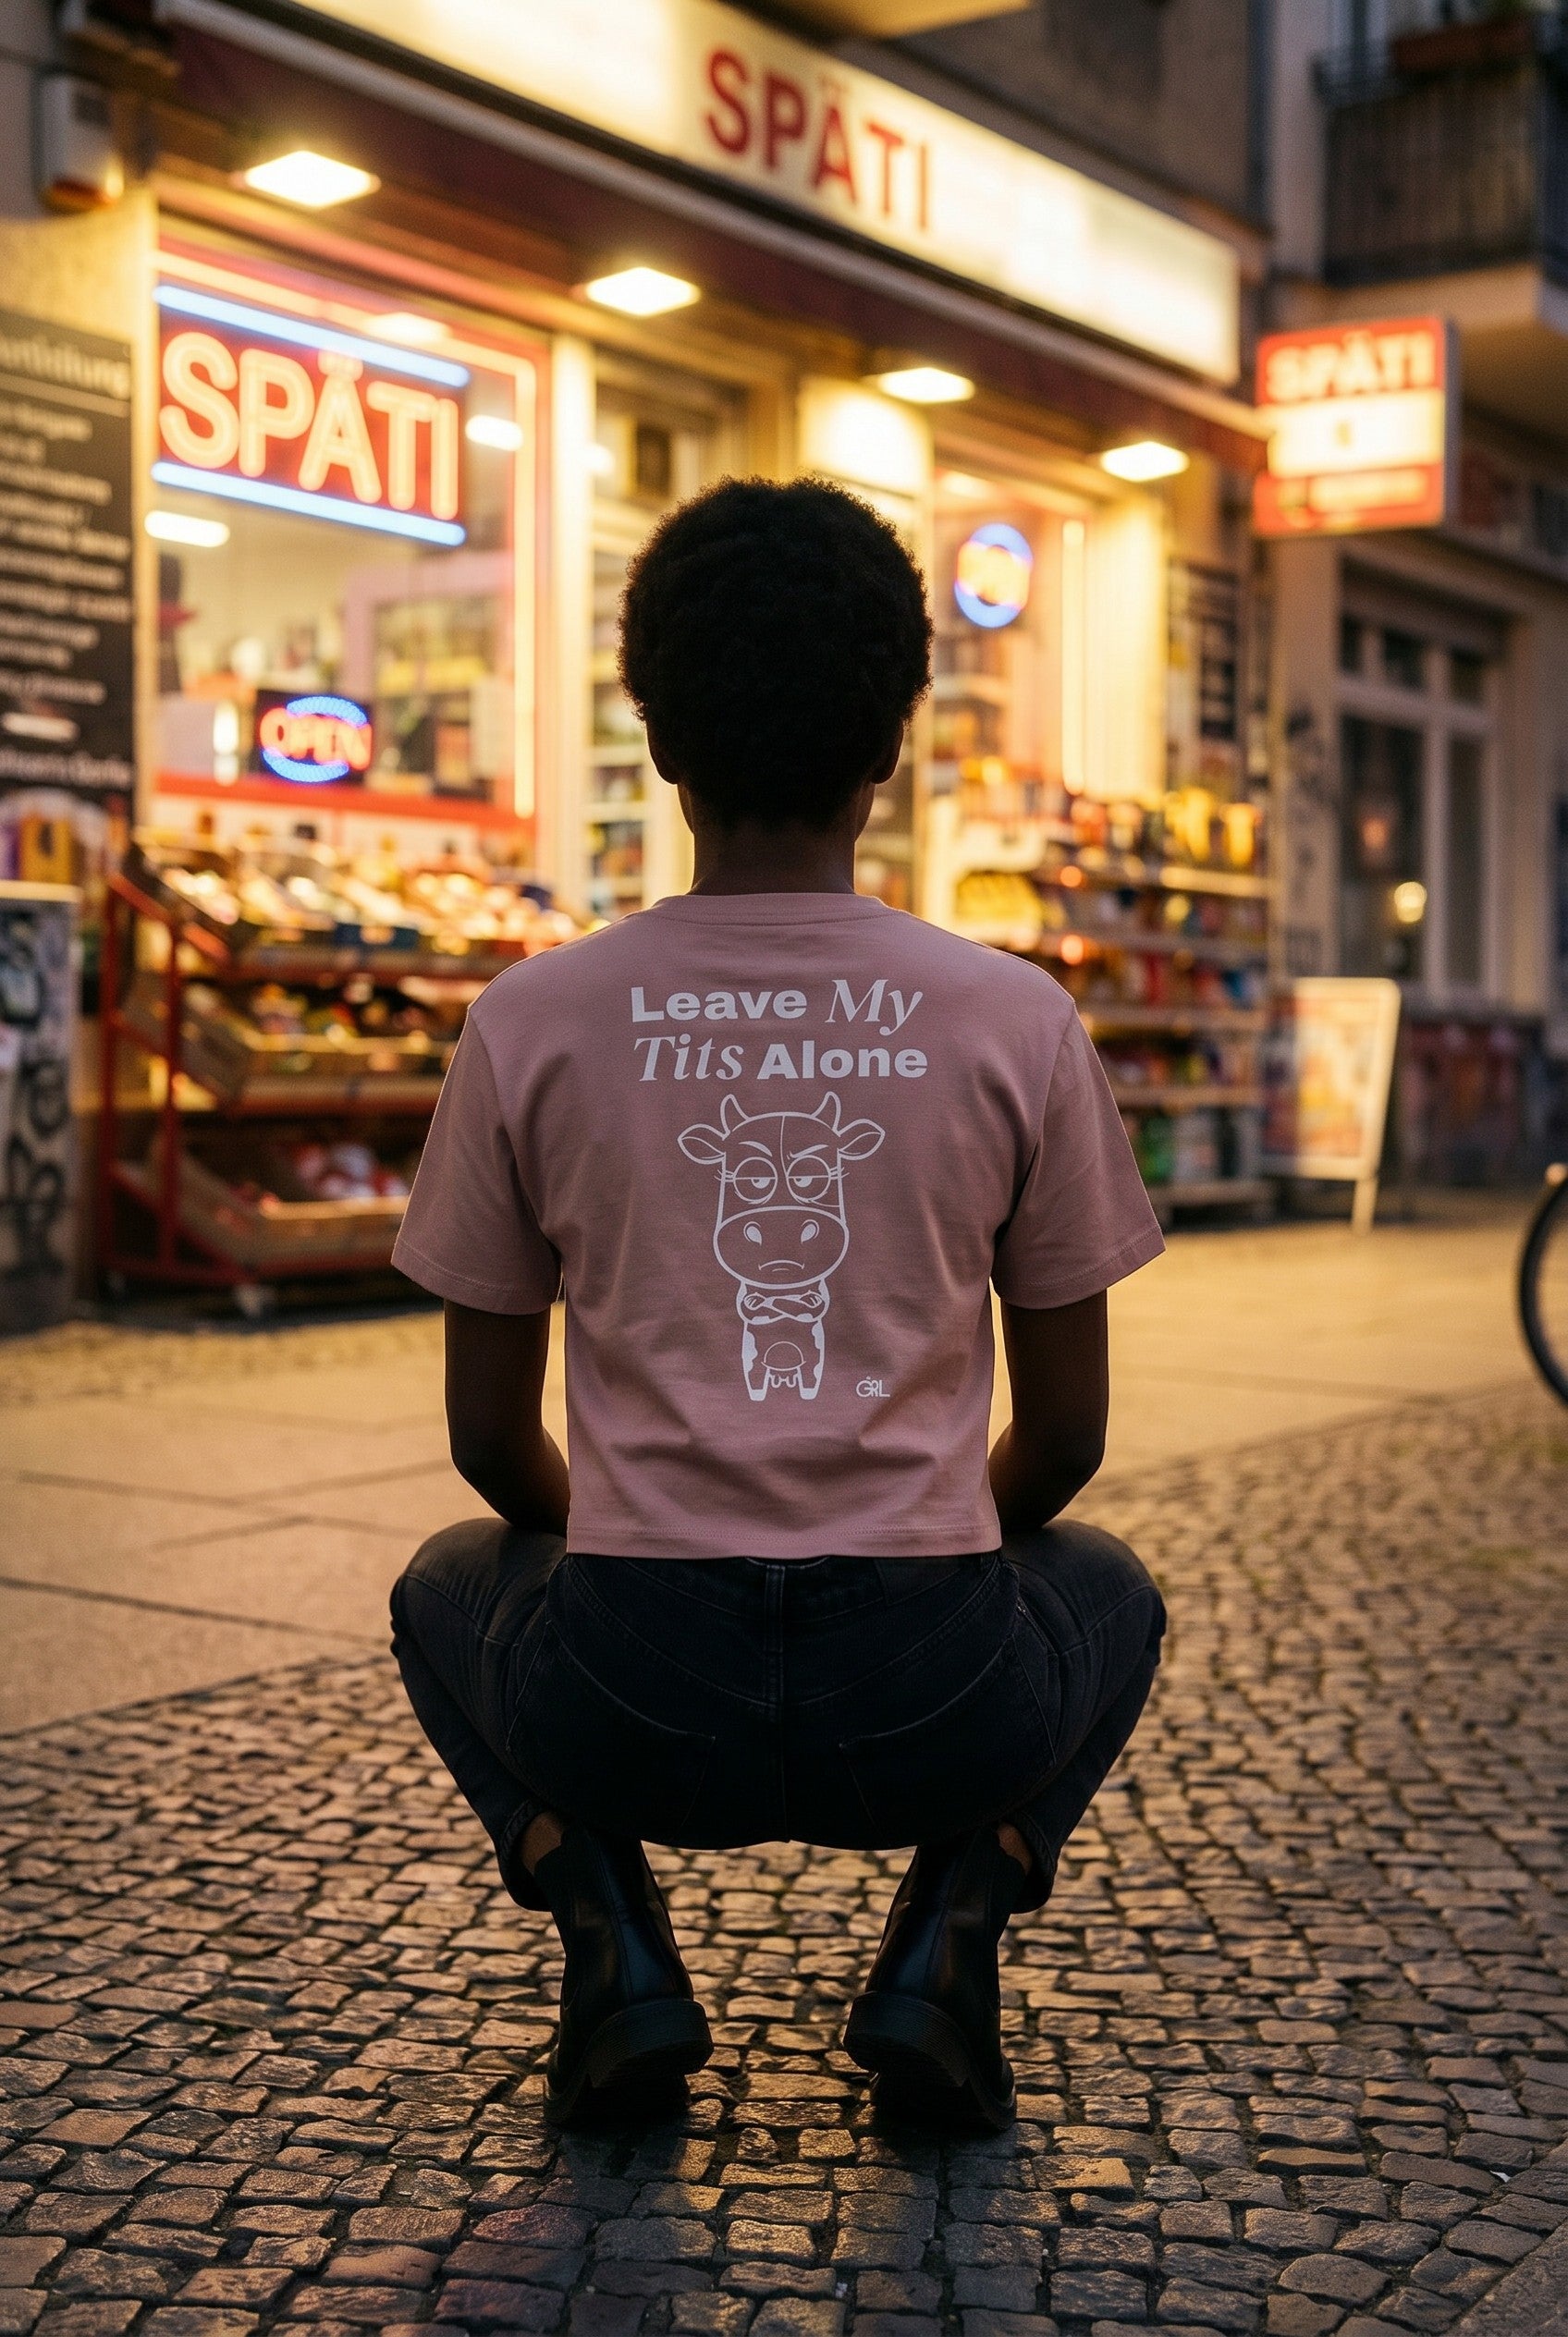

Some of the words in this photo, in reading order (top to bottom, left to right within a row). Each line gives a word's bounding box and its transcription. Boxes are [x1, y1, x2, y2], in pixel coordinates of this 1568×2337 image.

[704, 47, 930, 233] SPÄTI
[160, 331, 459, 520] SPÄTI
[260, 707, 372, 770] OPEN
[631, 986, 807, 1022] Leave
[825, 979, 924, 1036] My
[633, 1033, 744, 1082] Tits
[756, 1040, 928, 1080] Alone
